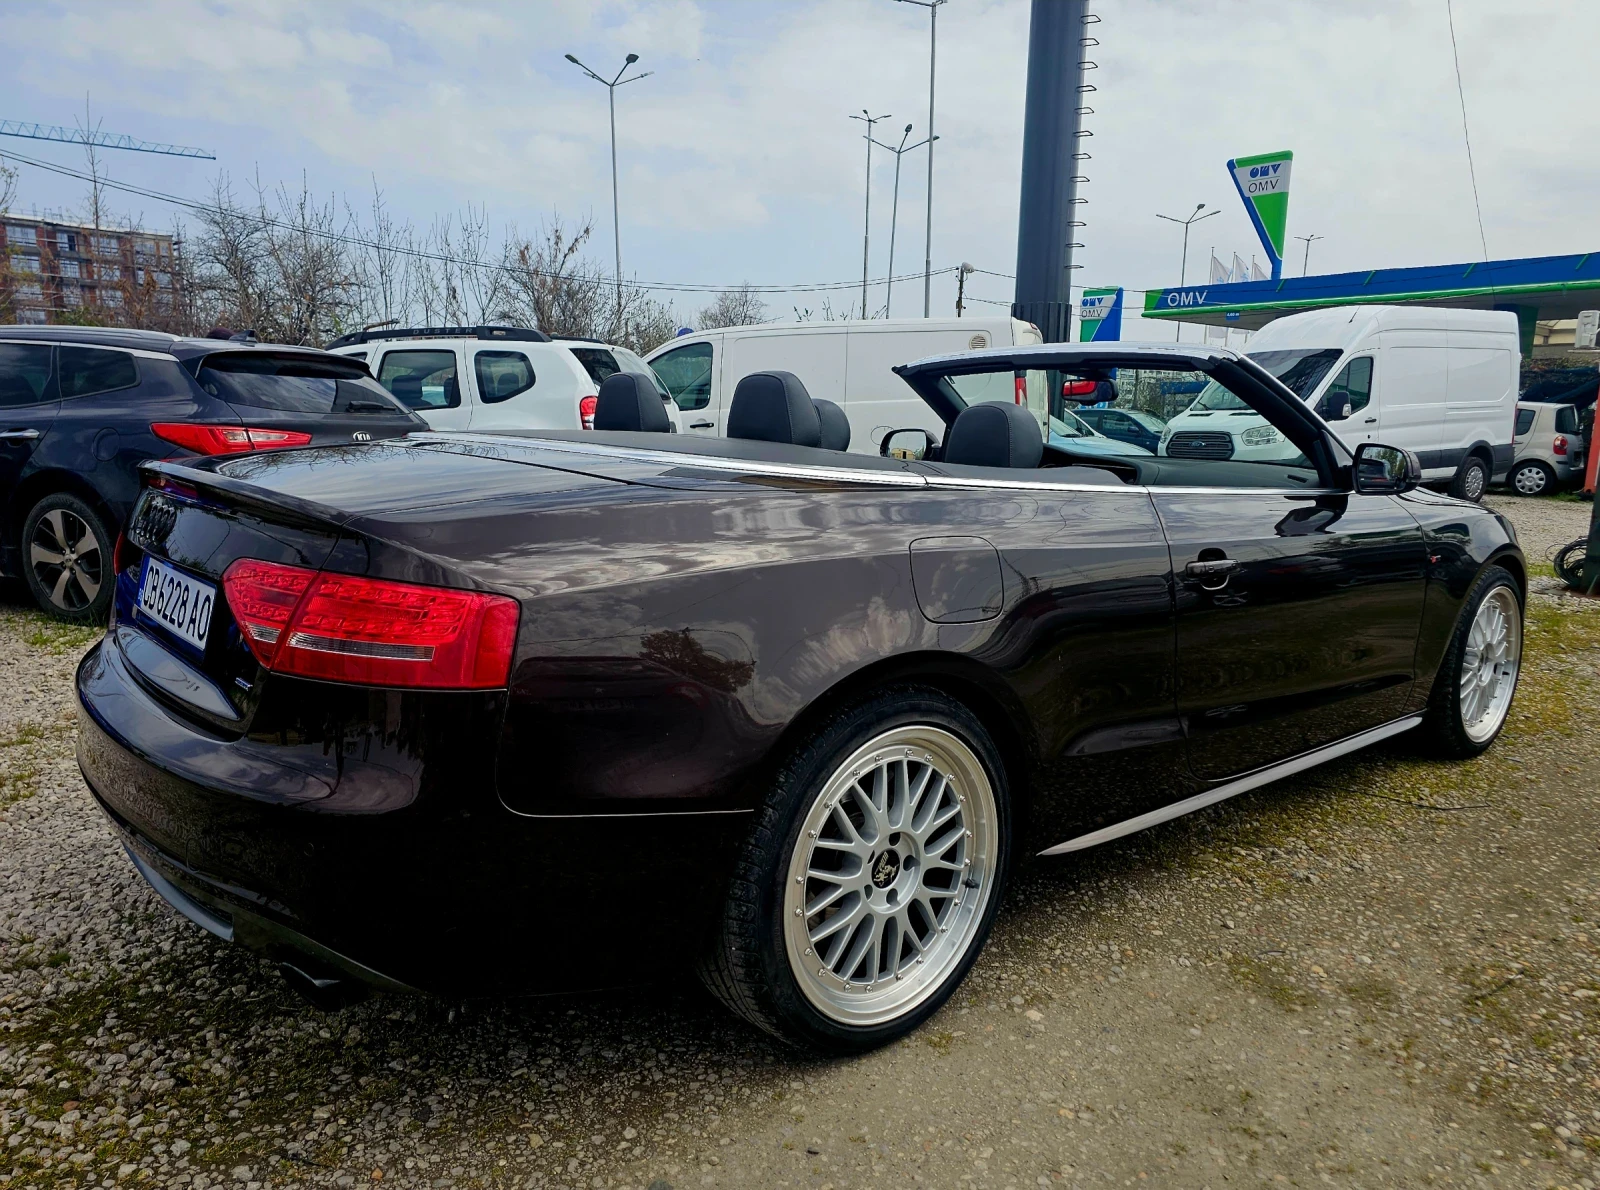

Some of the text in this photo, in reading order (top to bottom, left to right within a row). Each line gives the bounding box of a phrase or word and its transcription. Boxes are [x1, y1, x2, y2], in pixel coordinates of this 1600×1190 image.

[1248, 178, 1279, 193] OMV
[1167, 289, 1208, 307] OMV
[1081, 309, 1103, 318] OMV
[357, 433, 371, 441] KIA
